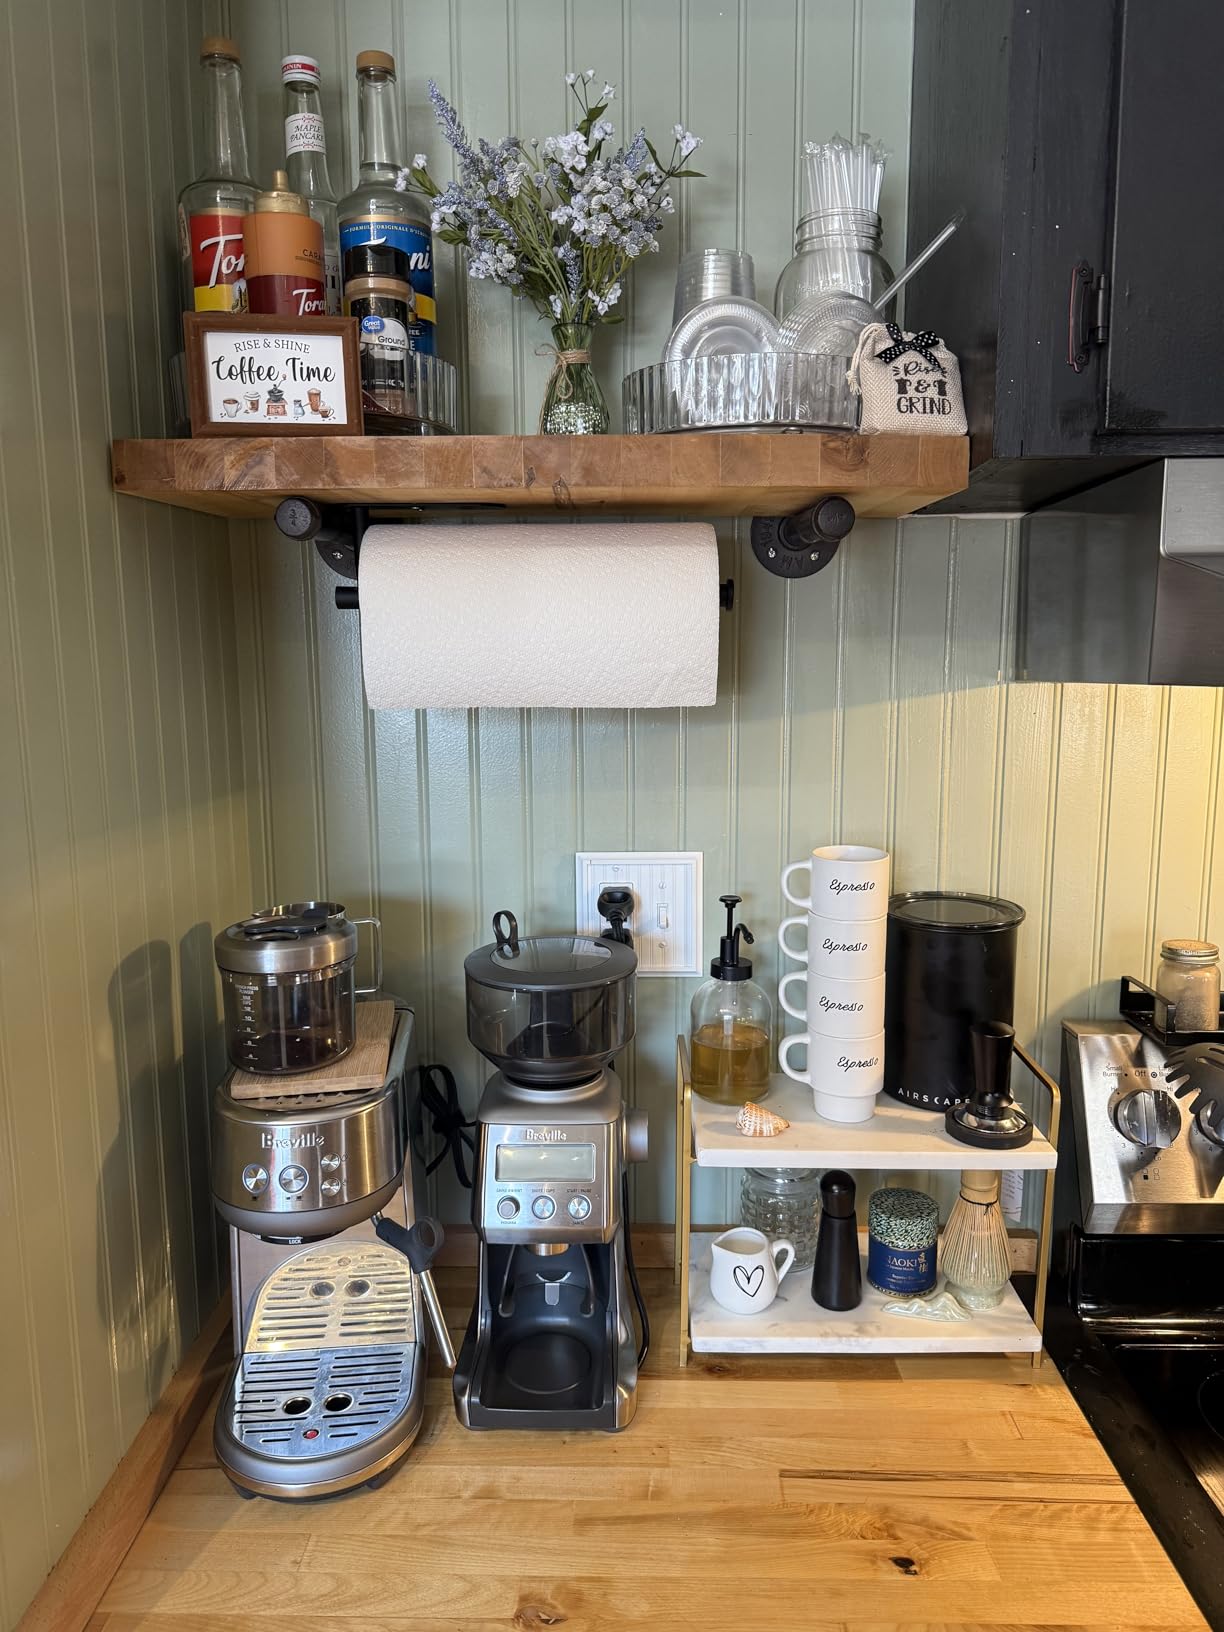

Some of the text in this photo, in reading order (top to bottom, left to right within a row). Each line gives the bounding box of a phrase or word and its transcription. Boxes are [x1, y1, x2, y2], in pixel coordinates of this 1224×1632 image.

[295, 124, 322, 133] MAPLE
[200, 233, 245, 289] Tor
[292, 288, 325, 316] Tora
[233, 338, 311, 354] RISE & SHINE
[378, 335, 405, 346] Ground
[211, 355, 336, 385] Coffee Time
[914, 379, 931, 393] &
[896, 396, 952, 415] GRIND
[829, 878, 875, 895] Espresso
[822, 938, 867, 954] Espresso
[818, 996, 864, 1012] Espresso
[837, 1056, 879, 1072] Espresso
[898, 1087, 970, 1106] AIRSCAPE
[261, 1132, 325, 1149] Breville
[526, 1128, 568, 1141] Breville
